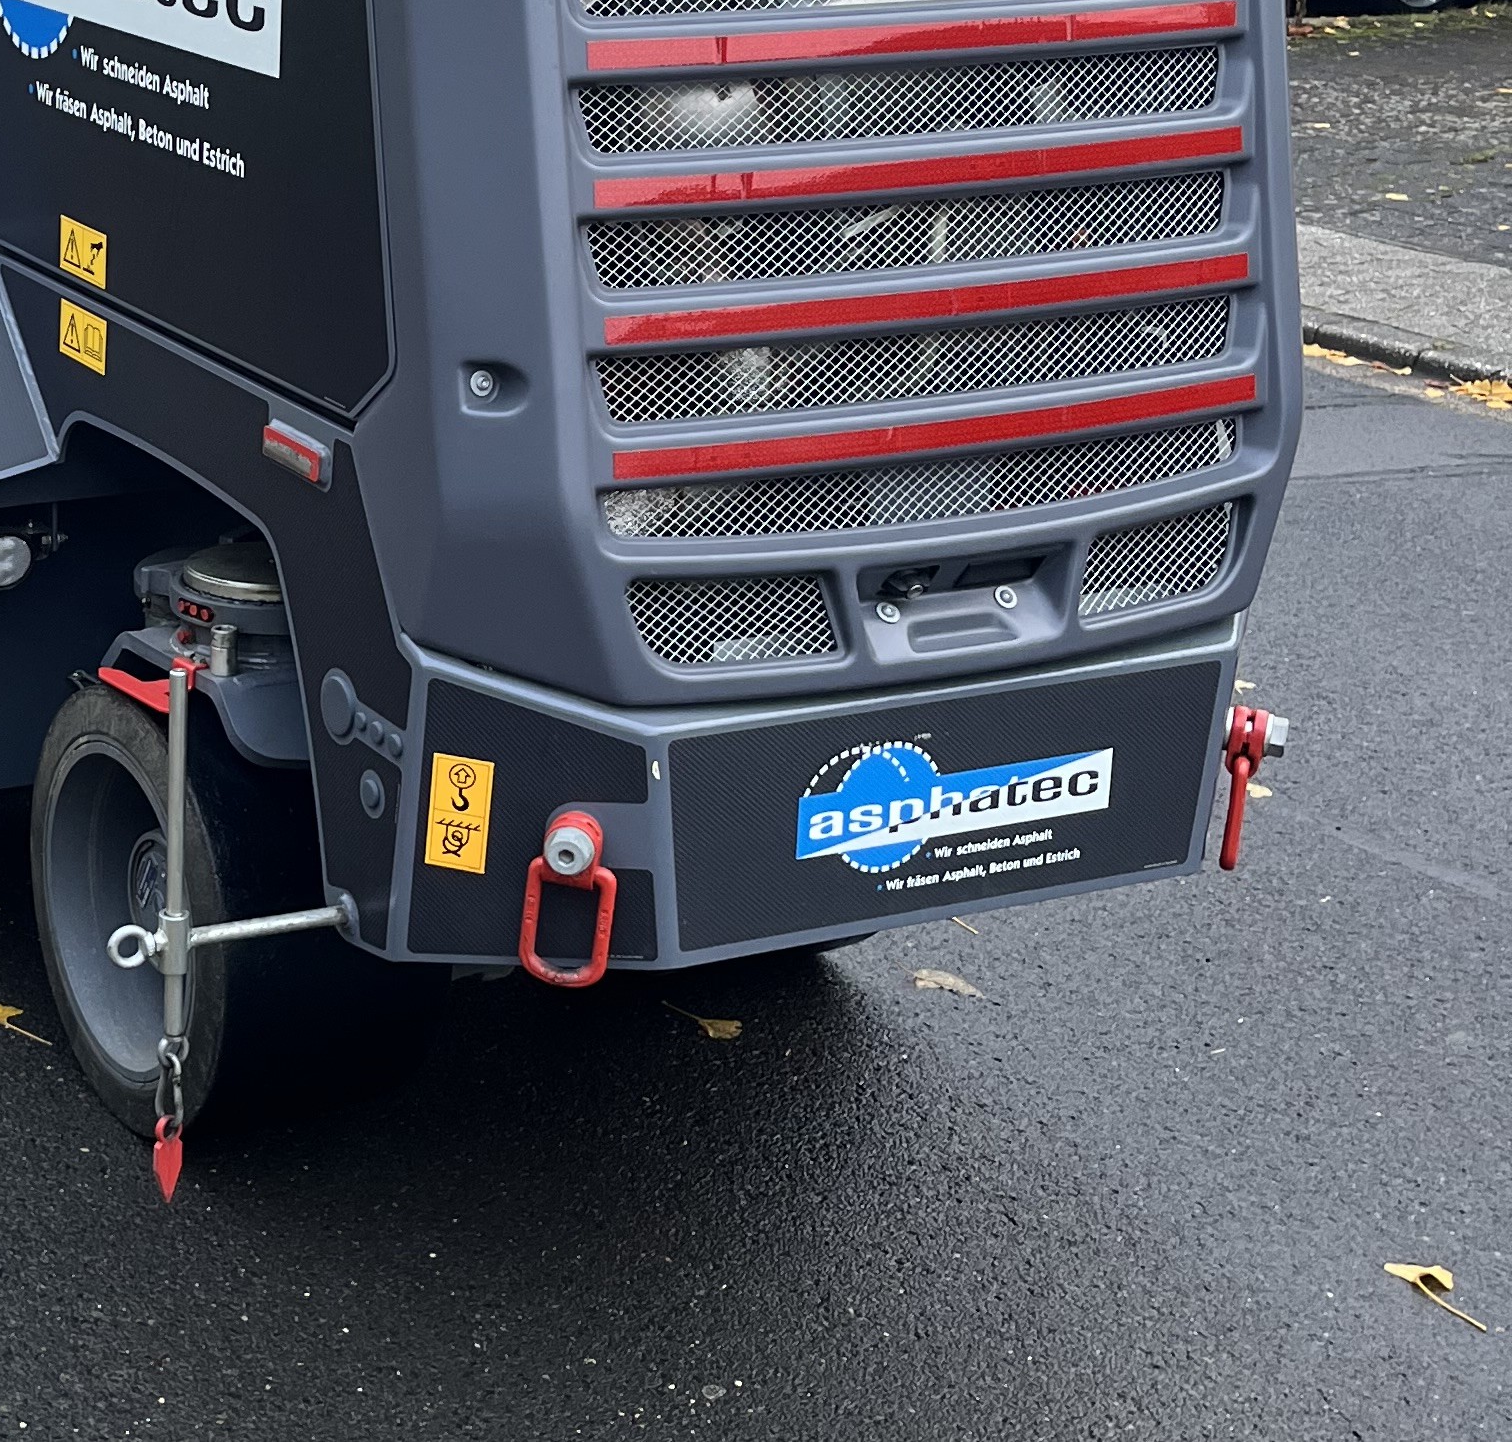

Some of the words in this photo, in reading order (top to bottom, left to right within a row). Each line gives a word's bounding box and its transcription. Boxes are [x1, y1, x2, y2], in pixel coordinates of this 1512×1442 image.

[80, 45, 99, 72] Wir
[102, 56, 160, 93] schneiden
[163, 77, 210, 110] Asphalt
[36, 80, 54, 107] Wir
[55, 88, 87, 119] fräsen
[90, 103, 136, 142] Asphalt,
[138, 118, 173, 151] Beton
[176, 137, 200, 162] und
[202, 142, 245, 178] Estrich
[808, 768, 1100, 841] asphatec
[885, 879, 904, 892] Wir
[906, 871, 939, 889] fräsen
[942, 863, 987, 884] Asphalt,
[989, 858, 1021, 875] Beton
[1023, 853, 1044, 869] und
[1046, 846, 1081, 864] Estrich
[934, 845, 954, 859] Wir
[956, 836, 1011, 857] schneiden
[1012, 828, 1053, 848] Asphalt
